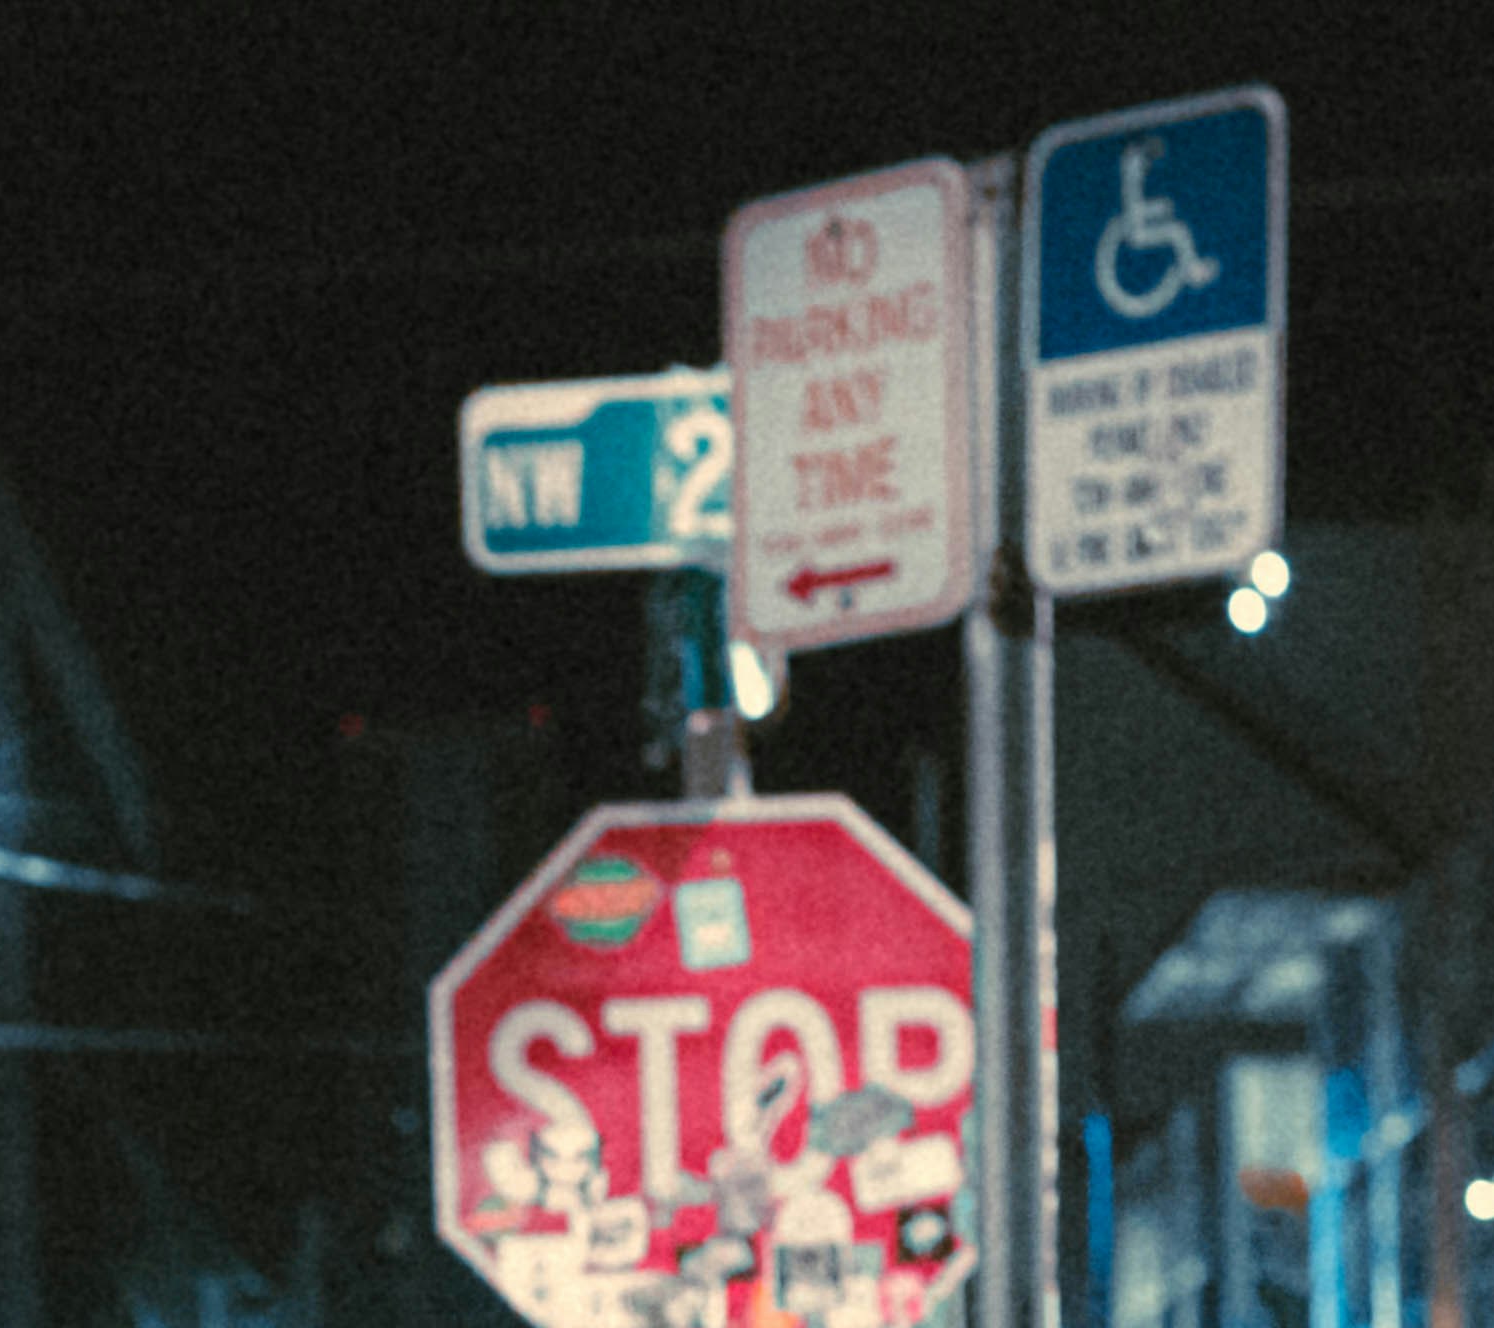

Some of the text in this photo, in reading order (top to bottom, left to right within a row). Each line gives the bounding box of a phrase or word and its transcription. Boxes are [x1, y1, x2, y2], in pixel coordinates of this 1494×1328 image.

[805, 216, 880, 288] NO
[484, 438, 584, 529] NW
[488, 987, 976, 1208] STOP
